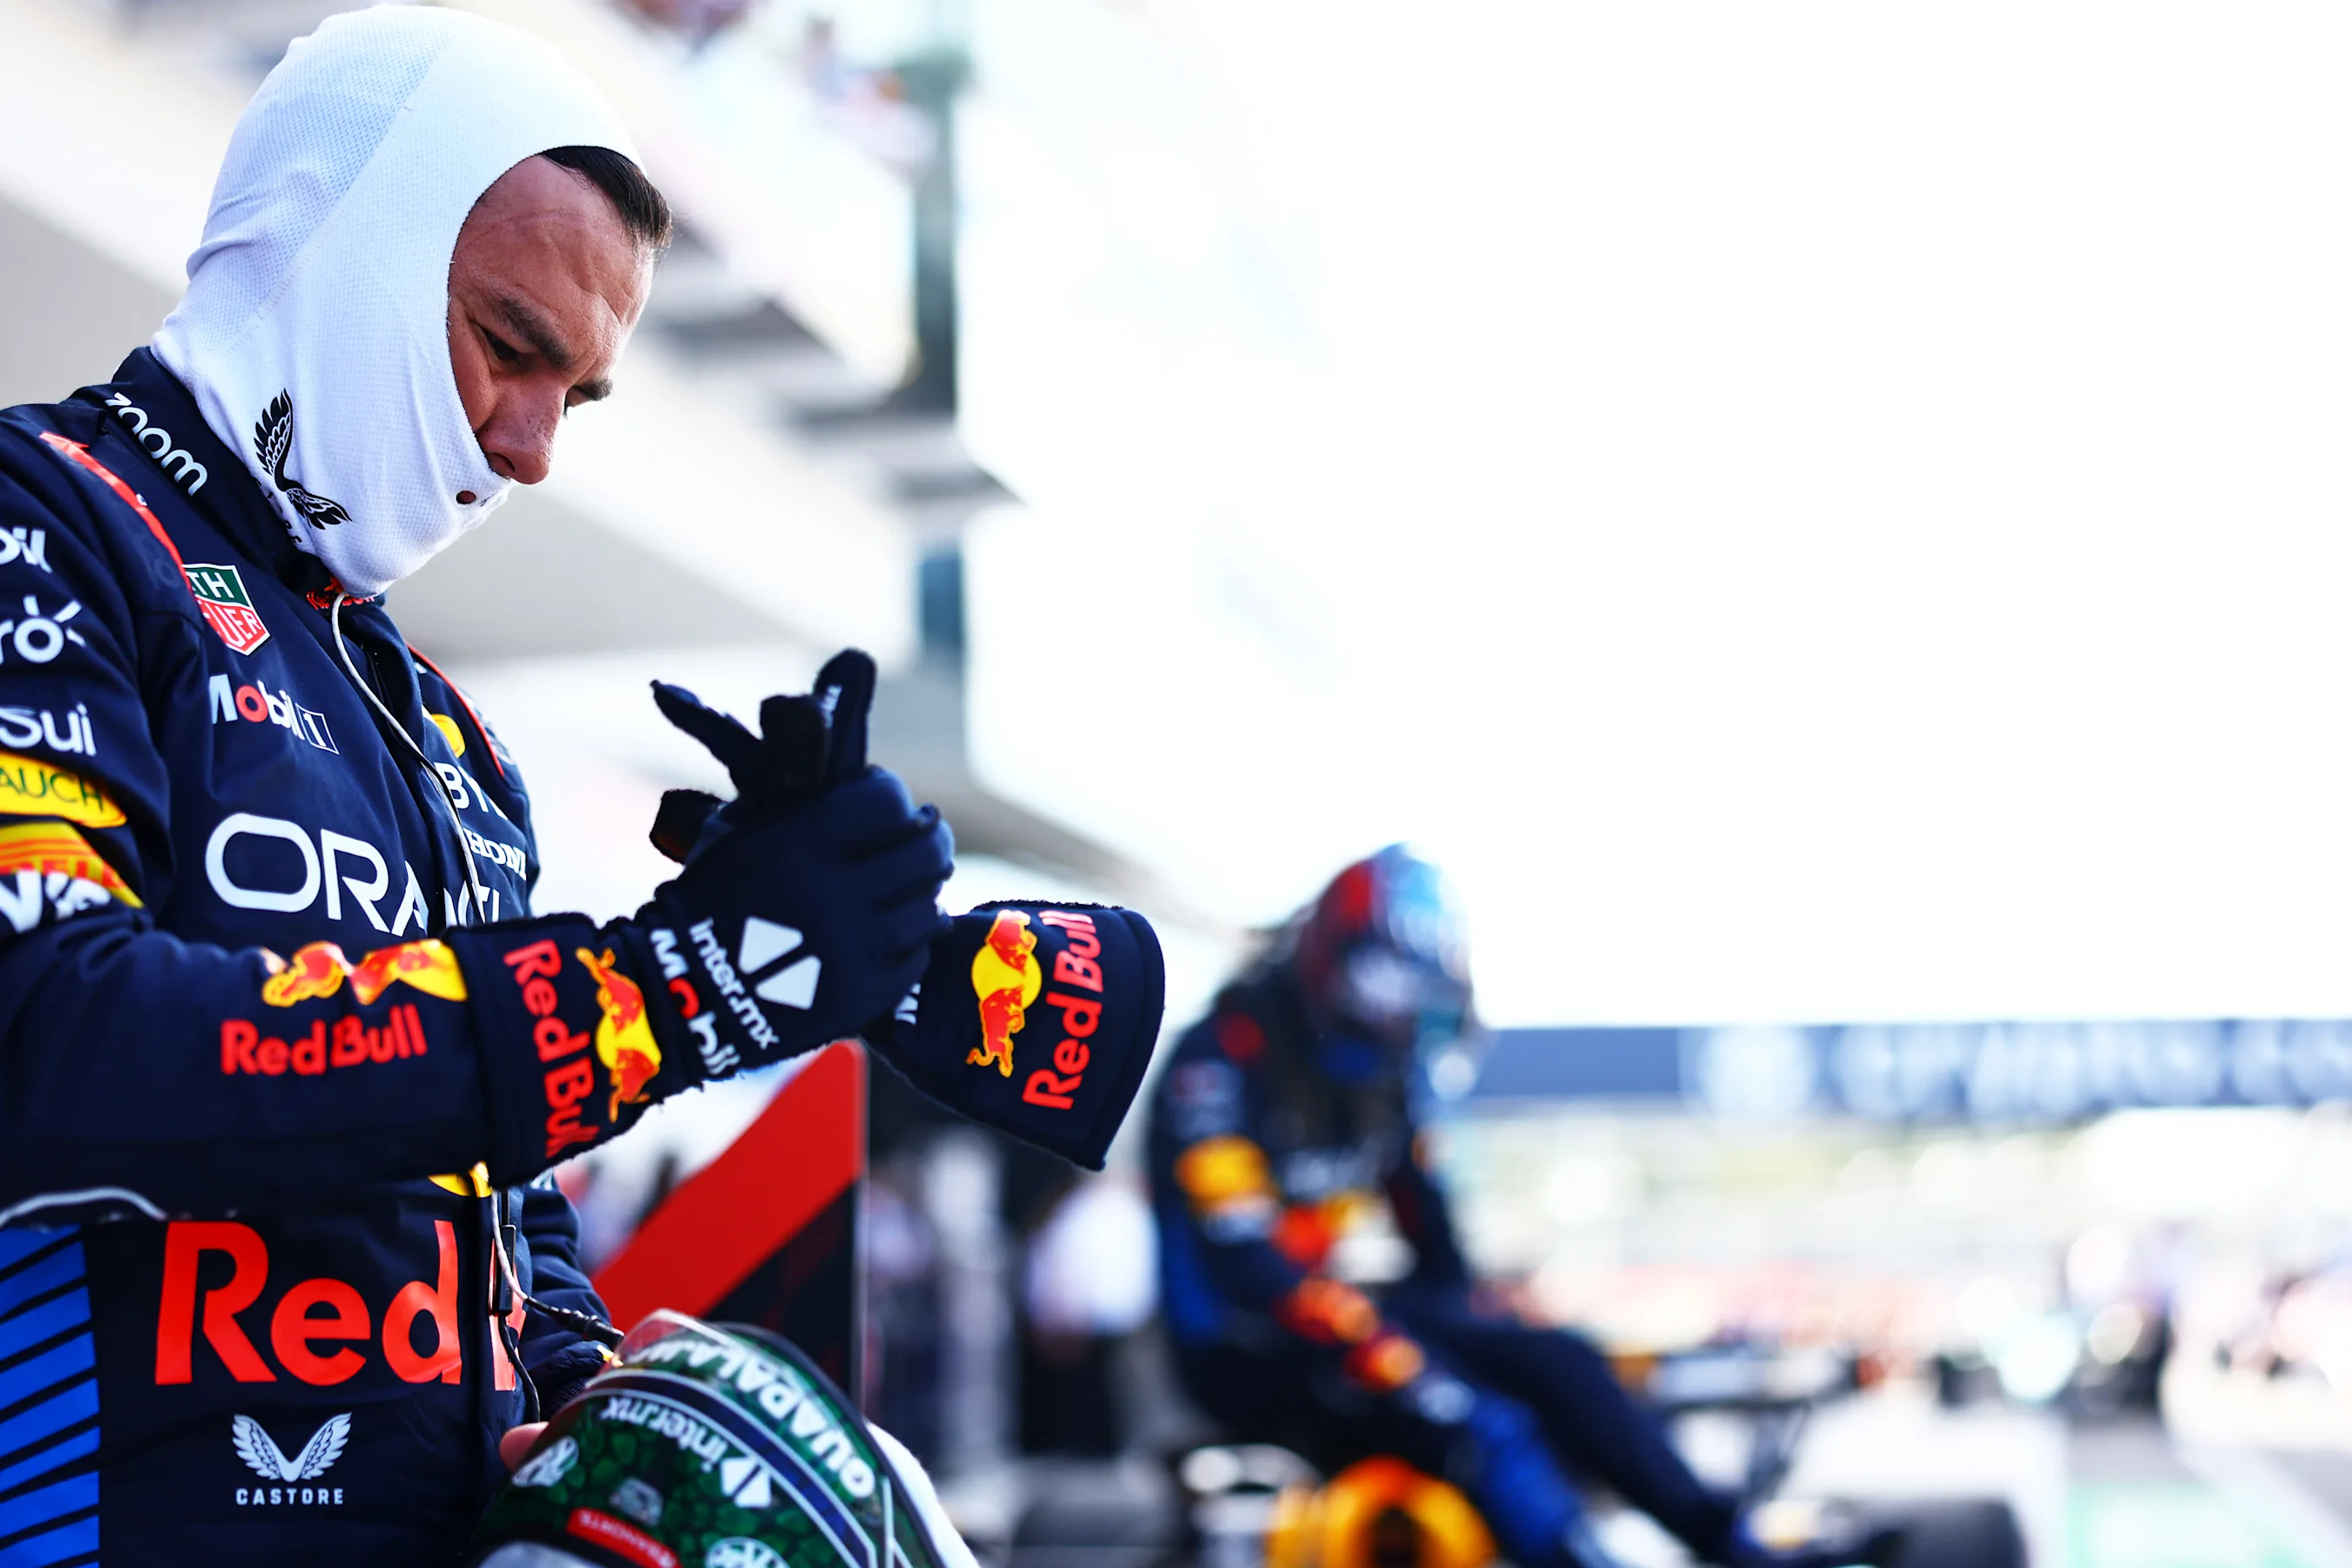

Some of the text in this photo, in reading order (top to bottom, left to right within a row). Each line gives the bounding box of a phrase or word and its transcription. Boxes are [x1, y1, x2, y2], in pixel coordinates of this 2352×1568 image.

[105, 392, 208, 497] zoom
[220, 1003, 428, 1076] Red Bull
[503, 939, 591, 1063] Red
[1022, 910, 1103, 1110] Red Bull
[155, 1221, 463, 1386] Red
[235, 1488, 343, 1505] CASTORE
